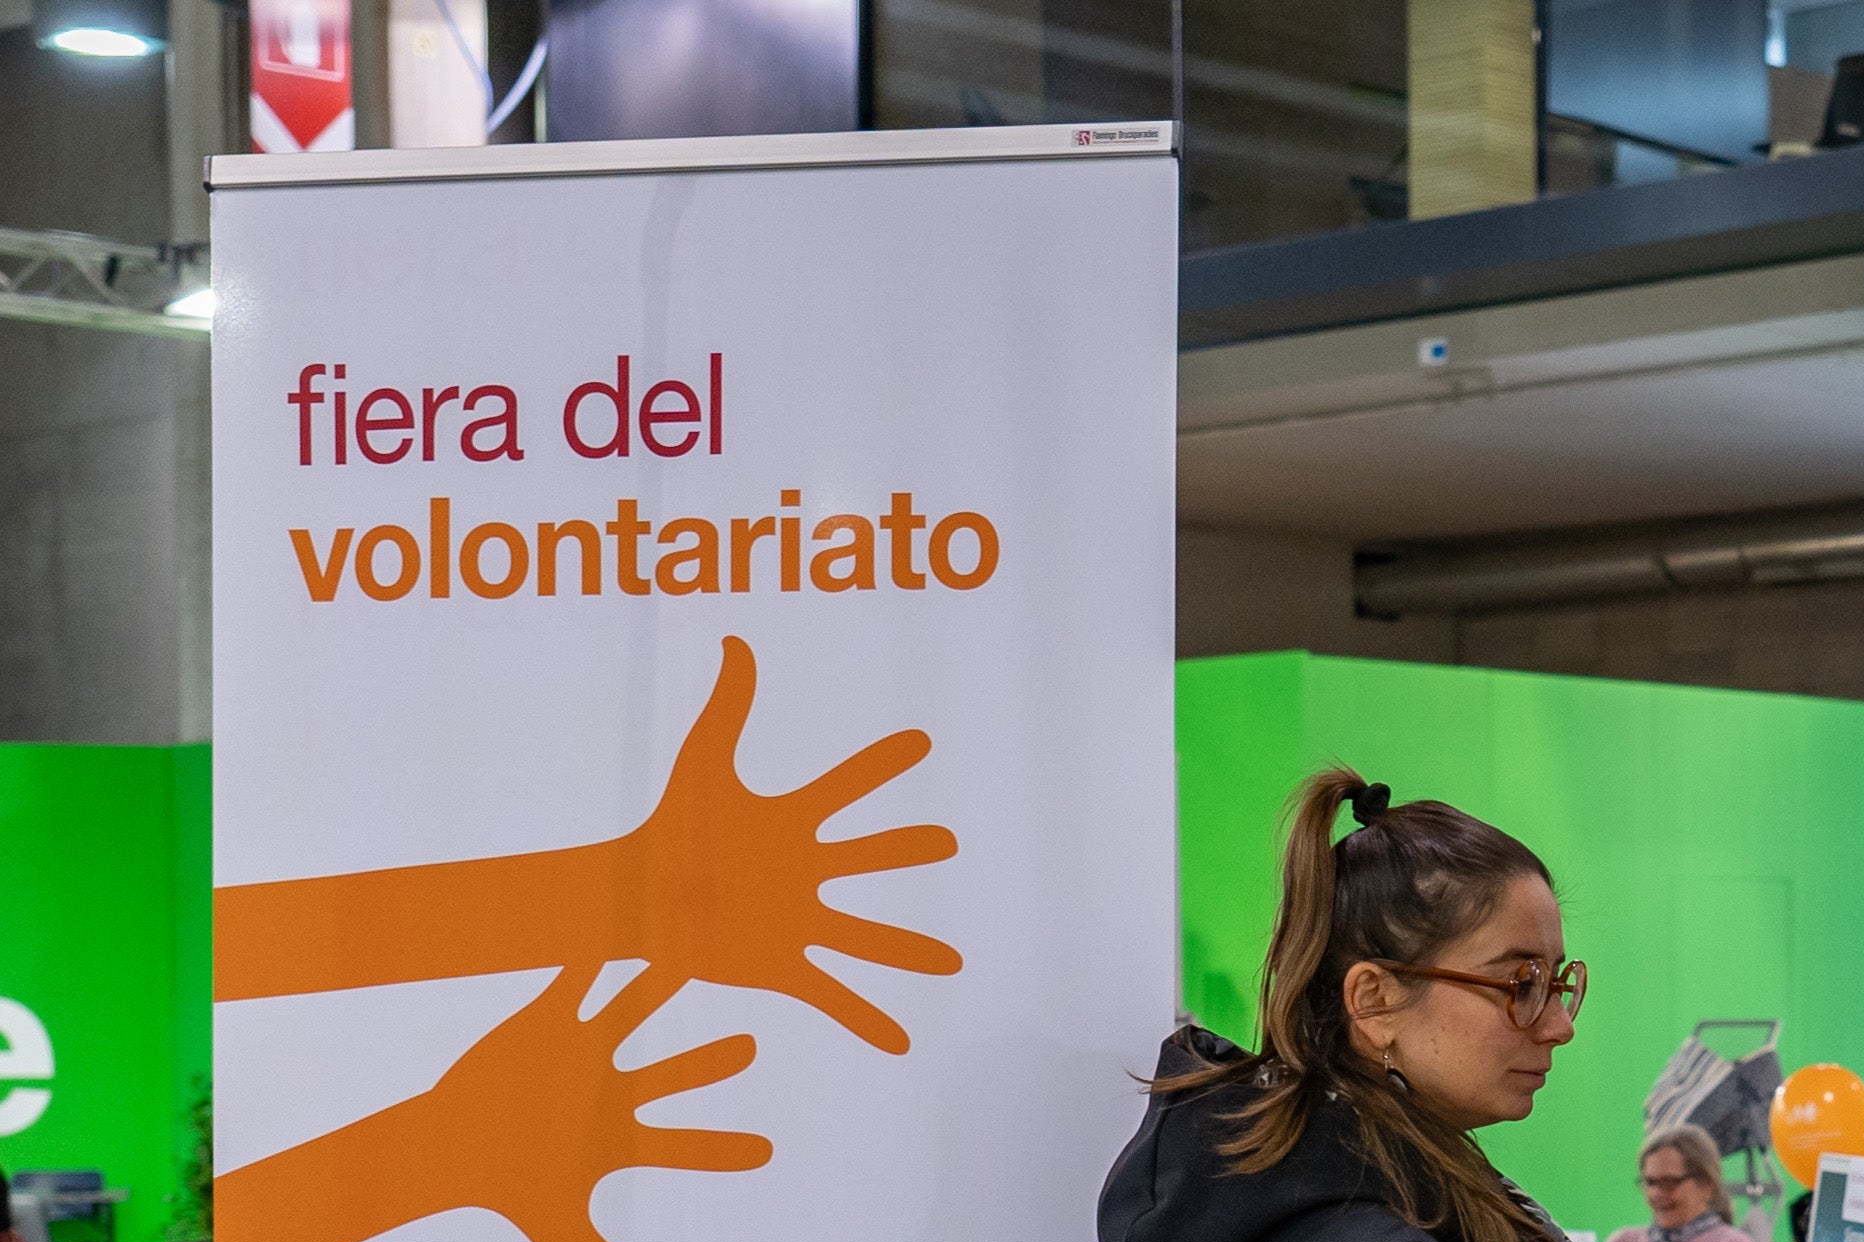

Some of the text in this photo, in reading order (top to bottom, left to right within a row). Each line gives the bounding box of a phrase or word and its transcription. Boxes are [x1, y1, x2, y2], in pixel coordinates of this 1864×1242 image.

[287, 353, 723, 466] fiera del
[288, 488, 1000, 602] volontariato
